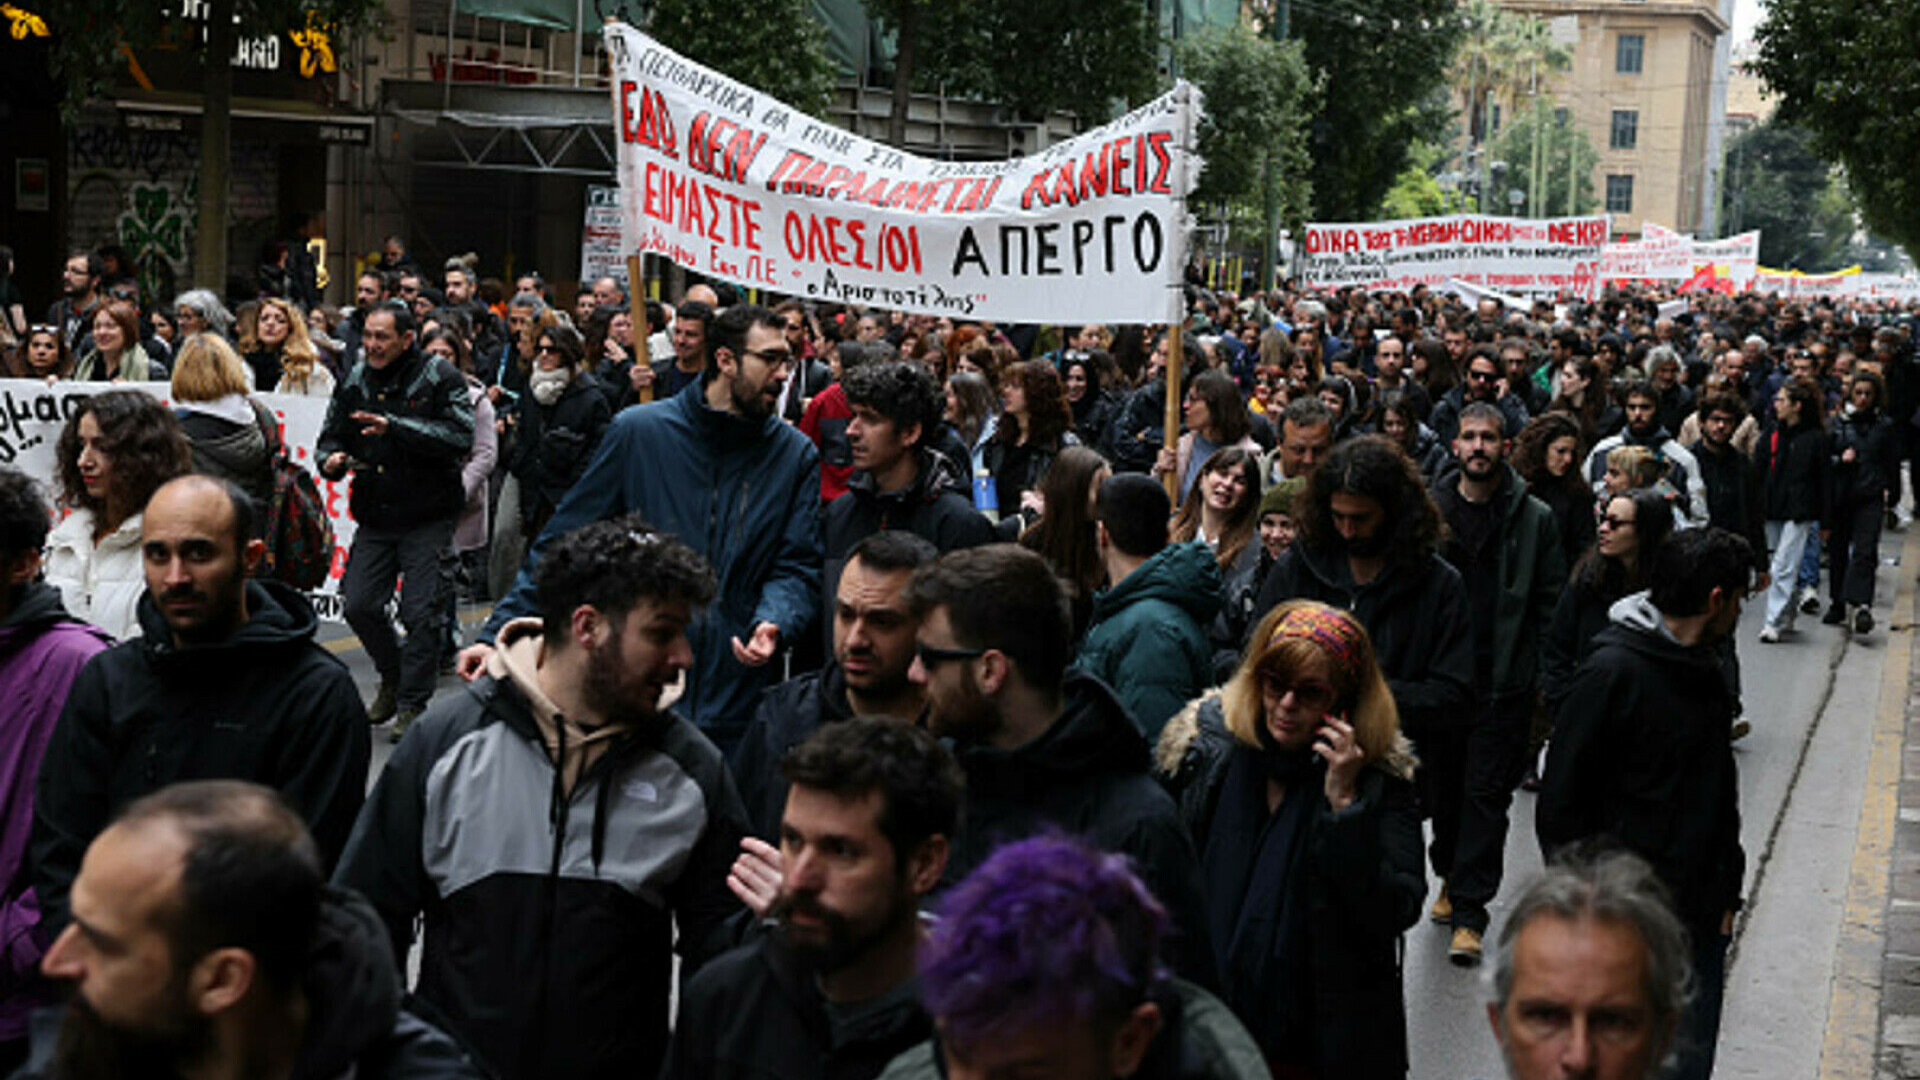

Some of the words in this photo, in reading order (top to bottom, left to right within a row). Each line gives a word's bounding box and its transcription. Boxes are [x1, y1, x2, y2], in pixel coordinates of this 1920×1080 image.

[688, 110, 769, 184] ΔΕΝ
[1020, 132, 1173, 210] ΚΑΝΕΙΣ
[643, 161, 762, 252] ΕΙΜΑΣΤΕ
[951, 210, 1163, 276] ΑΠΕΡΓΟ
